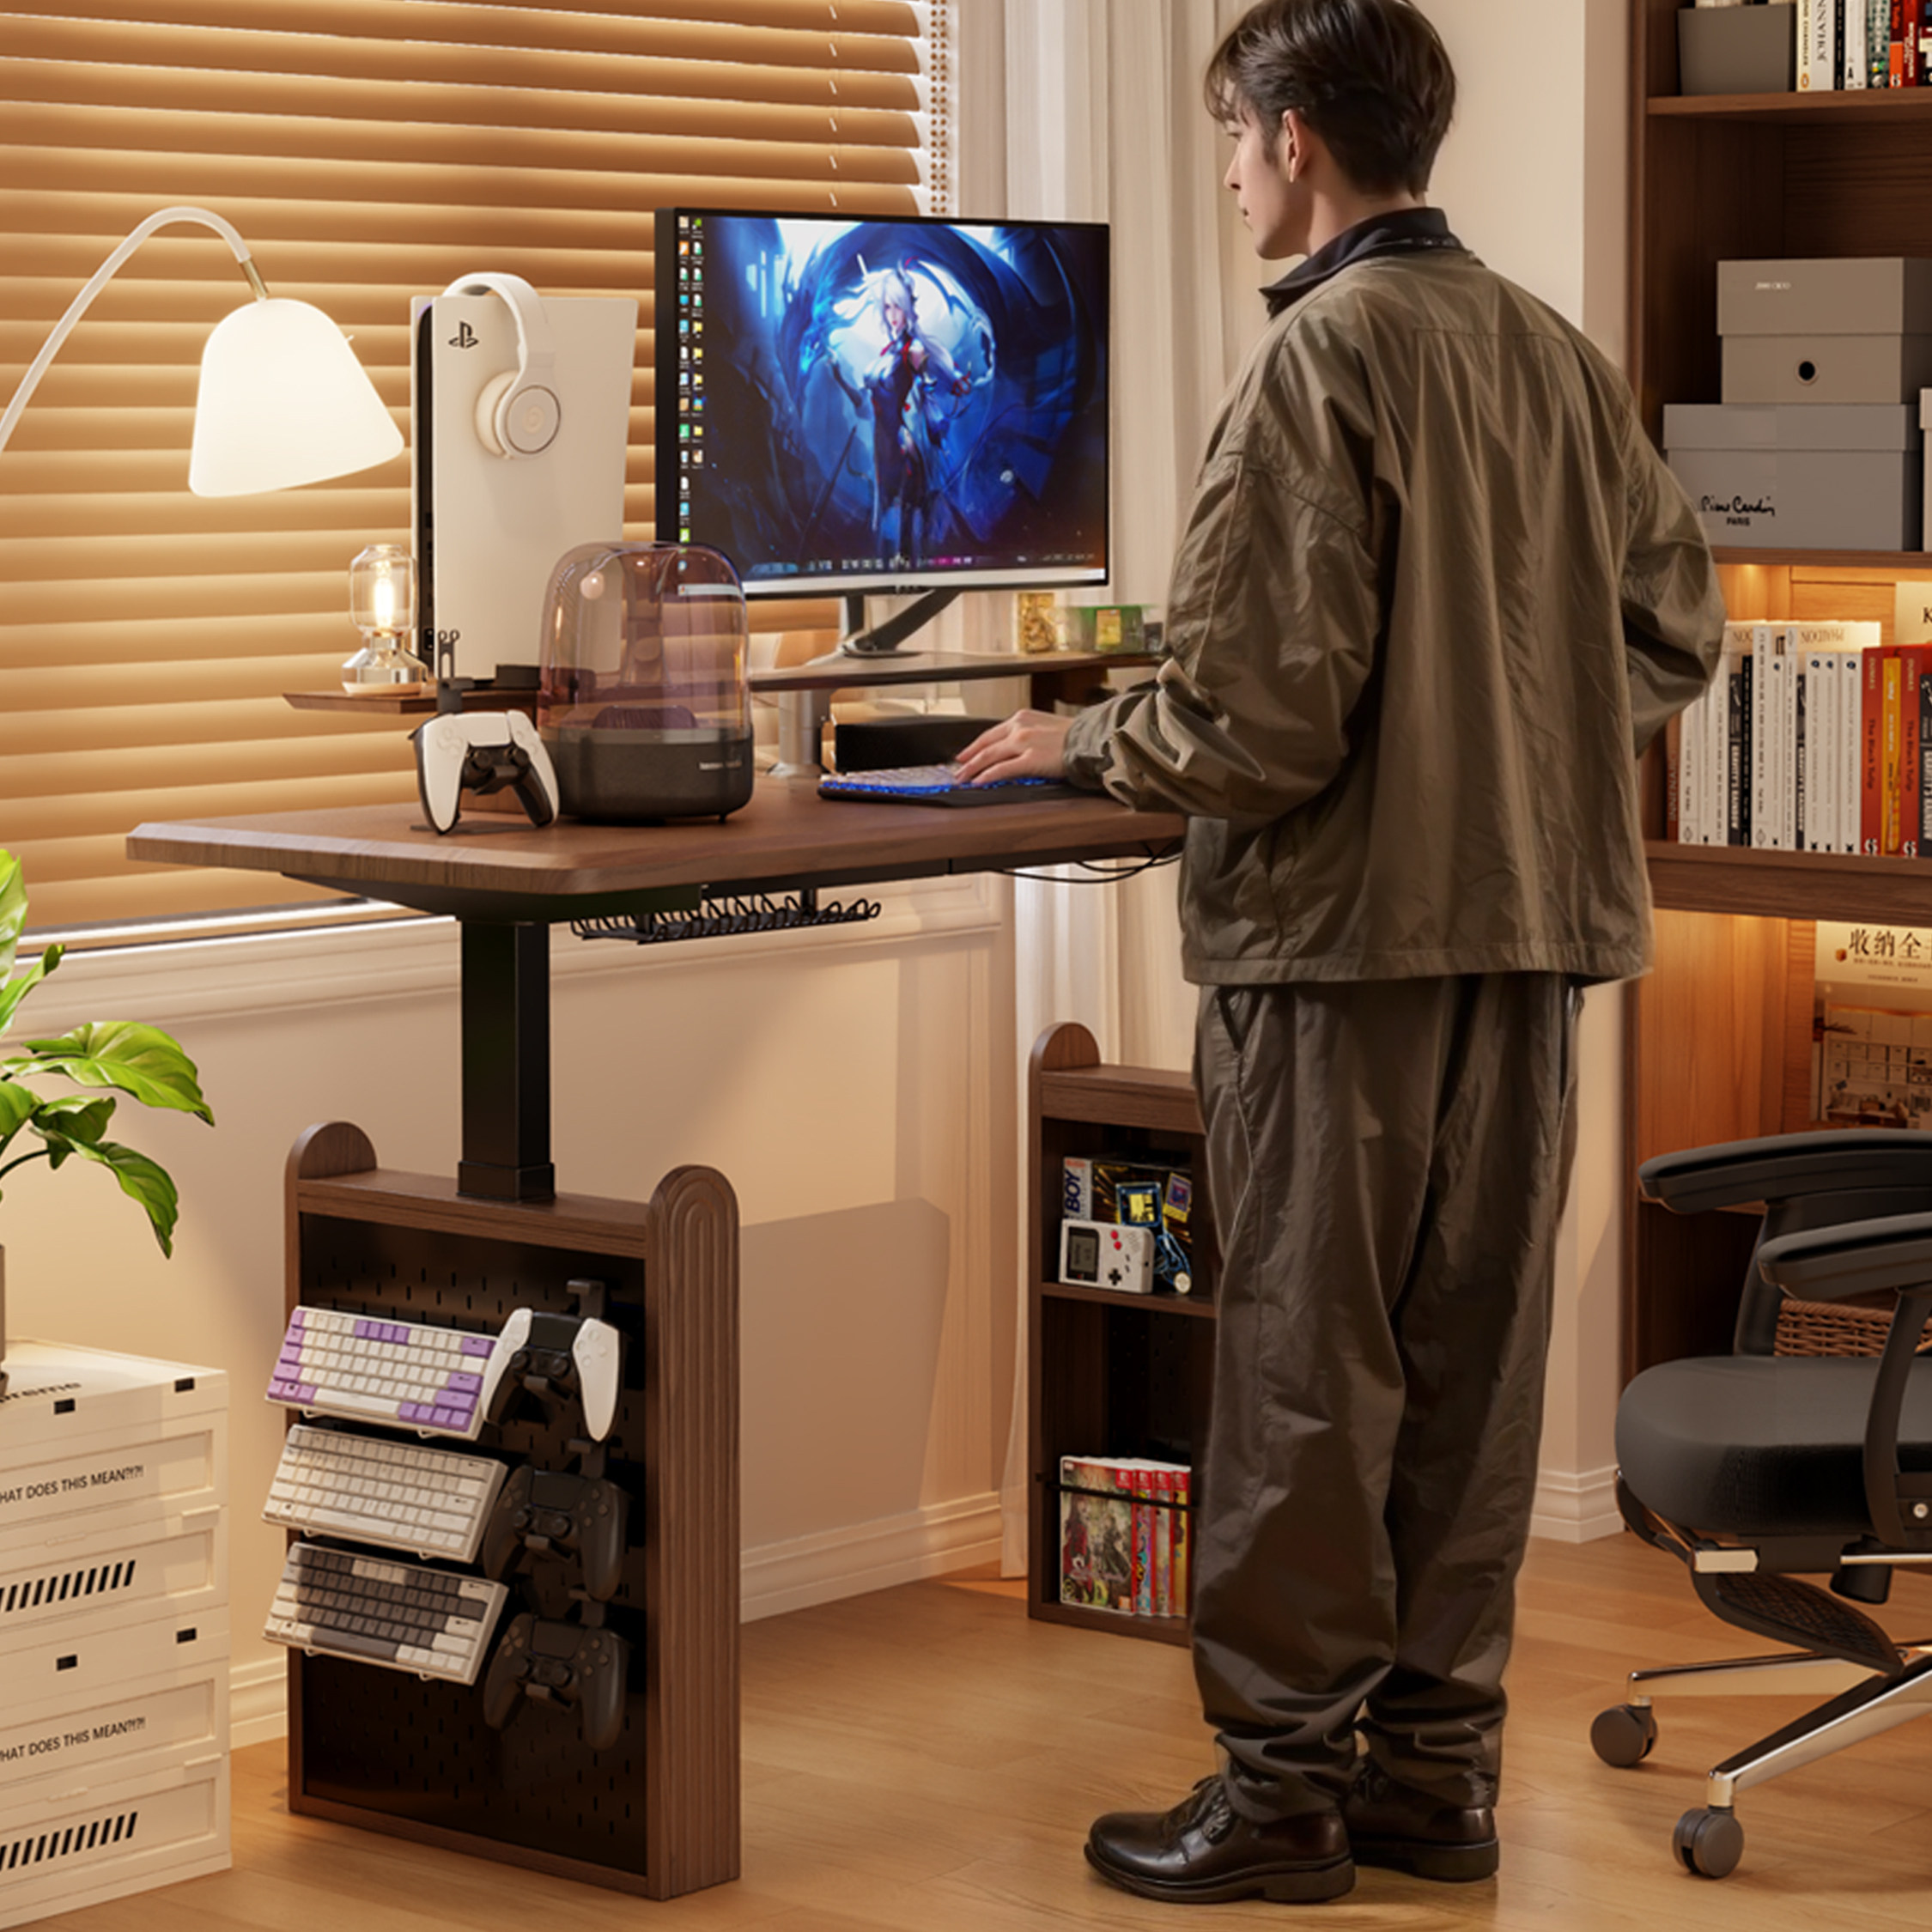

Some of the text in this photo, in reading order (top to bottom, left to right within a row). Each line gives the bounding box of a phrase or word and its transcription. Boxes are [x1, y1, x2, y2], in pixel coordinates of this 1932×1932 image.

[1727, 517, 1750, 526] PARIS
[1064, 1170, 1082, 1212] BOY
[0, 1487, 23, 1503] HAT
[26, 1480, 58, 1498] DOES
[61, 1475, 88, 1492] THIS
[28, 1736, 61, 1755] DOES
[64, 1730, 90, 1747] THIS
